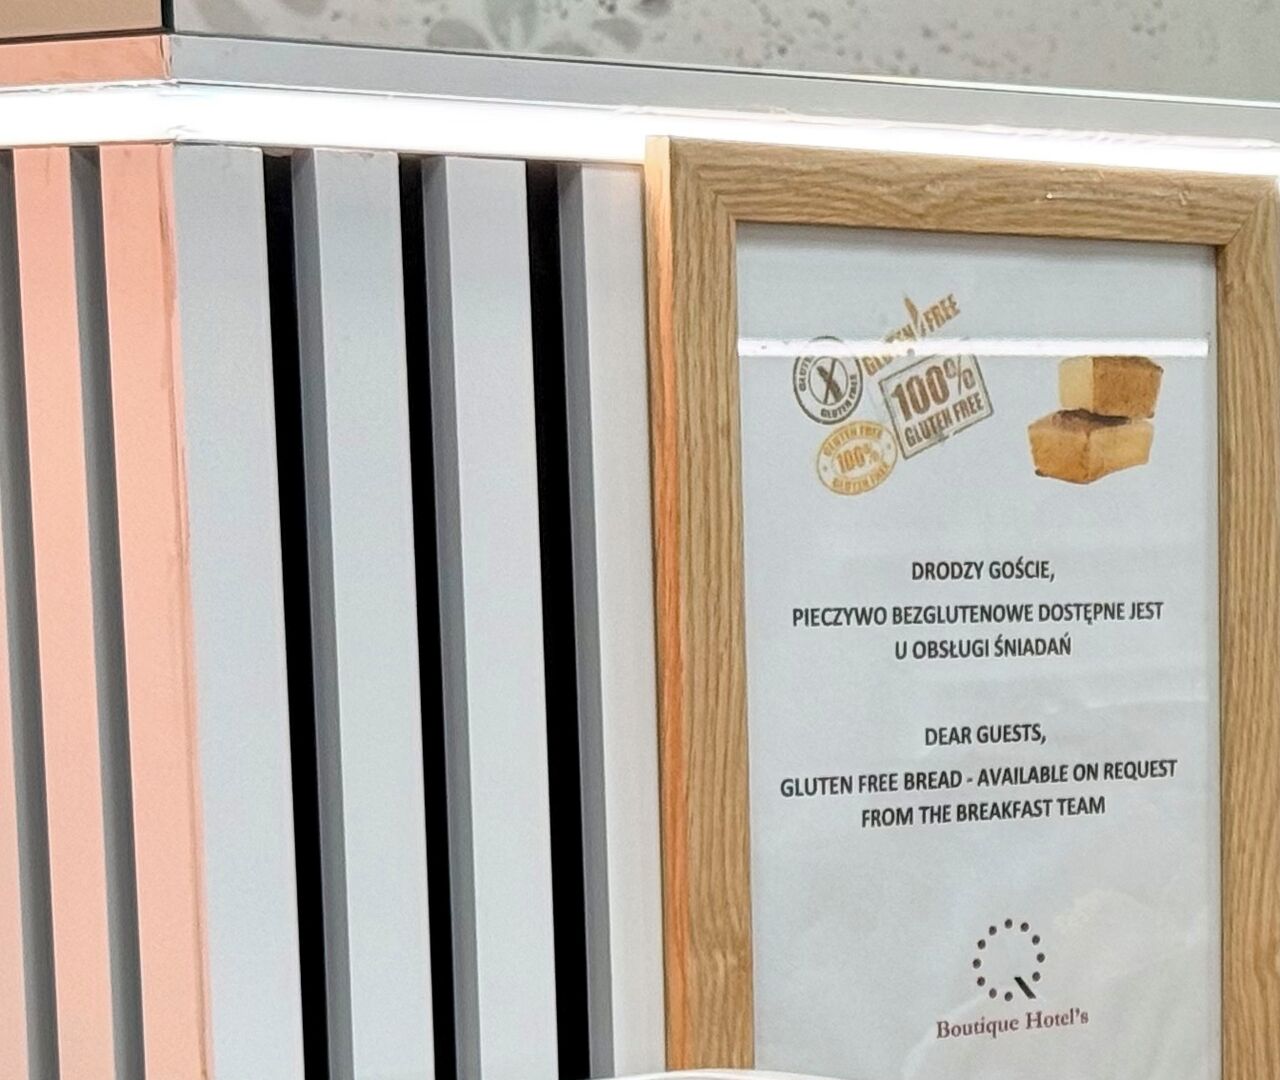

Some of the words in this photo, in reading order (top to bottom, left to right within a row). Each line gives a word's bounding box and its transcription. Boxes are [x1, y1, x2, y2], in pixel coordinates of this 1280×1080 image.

[891, 357, 976, 422] 100%
[904, 408, 954, 448] GLUTEN
[952, 391, 984, 424] FREE
[911, 561, 984, 581] DRODZY
[988, 555, 1056, 582] GOŚCIE,
[792, 606, 888, 626] PIECZYWO
[892, 603, 1034, 625] BEZGLUTENOWE
[1038, 602, 1126, 625] DOSTĘPNE
[1129, 601, 1164, 621] JEST
[895, 640, 908, 660] U
[912, 638, 990, 659] OBSŁUGI
[994, 632, 1072, 657] ŚNIADAŃ
[925, 726, 972, 747] DEAR
[976, 724, 1047, 746] GUESTS,
[780, 775, 853, 797] GLUTEN
[858, 773, 899, 793] FREE
[903, 770, 962, 791] BREAD
[976, 765, 1069, 788] AVAILABLE
[1073, 762, 1099, 782] ON
[1103, 759, 1178, 781] REQUEST
[861, 808, 914, 828] FROM
[918, 804, 952, 825] THE
[956, 799, 1054, 822] BREAKFAST
[1057, 796, 1106, 817] TEAM
[936, 1016, 1020, 1039] Boutique
[1025, 1007, 1090, 1030] Hotel's
